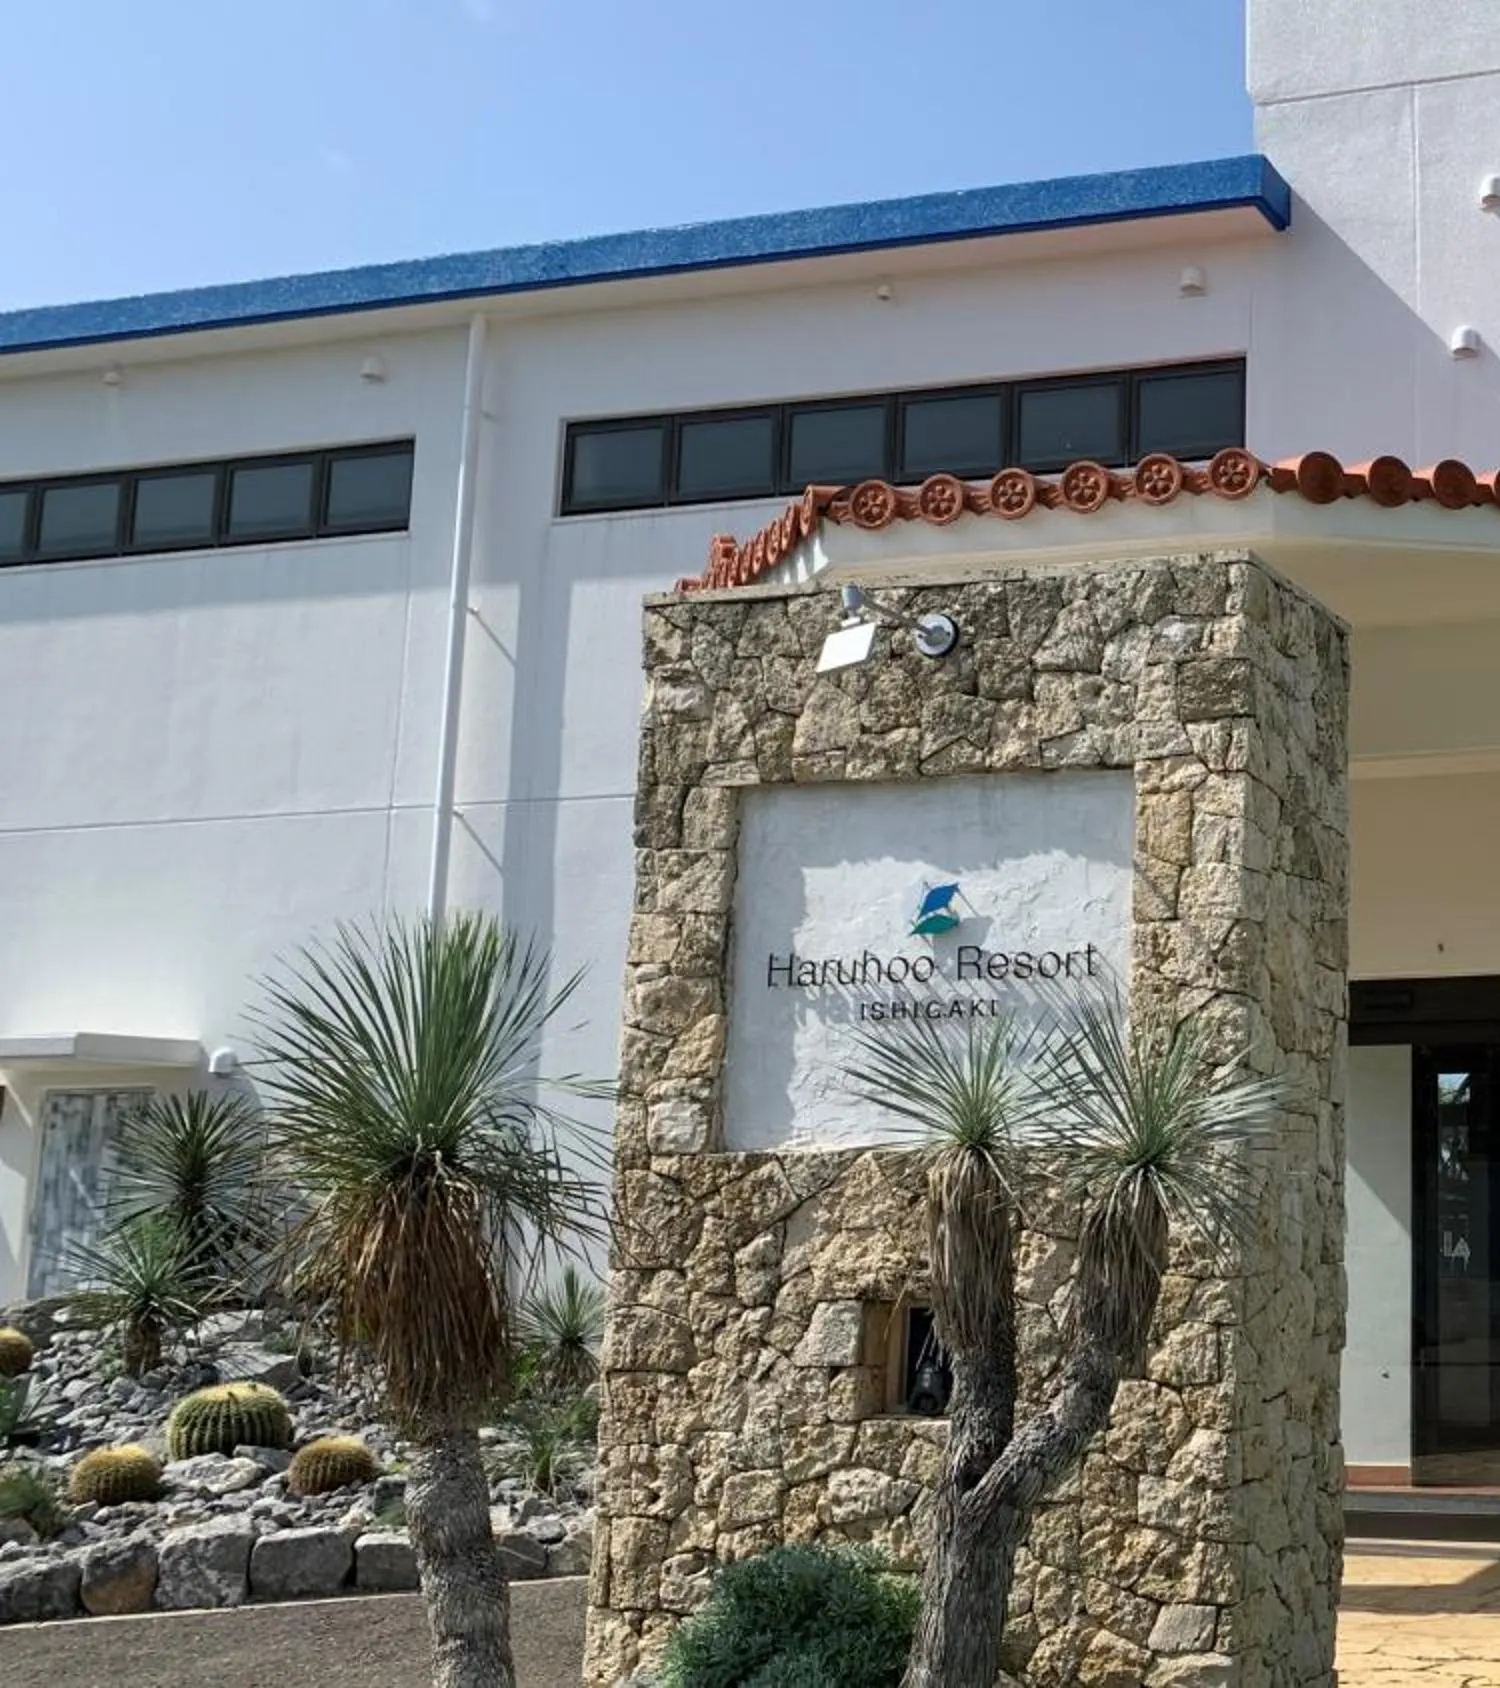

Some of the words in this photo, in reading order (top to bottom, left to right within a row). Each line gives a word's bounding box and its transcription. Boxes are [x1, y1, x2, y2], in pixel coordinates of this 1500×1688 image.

[767, 949, 935, 988] Haruhoo
[956, 942, 1098, 981] Resort
[860, 999, 999, 1022] ISHIGAKI
